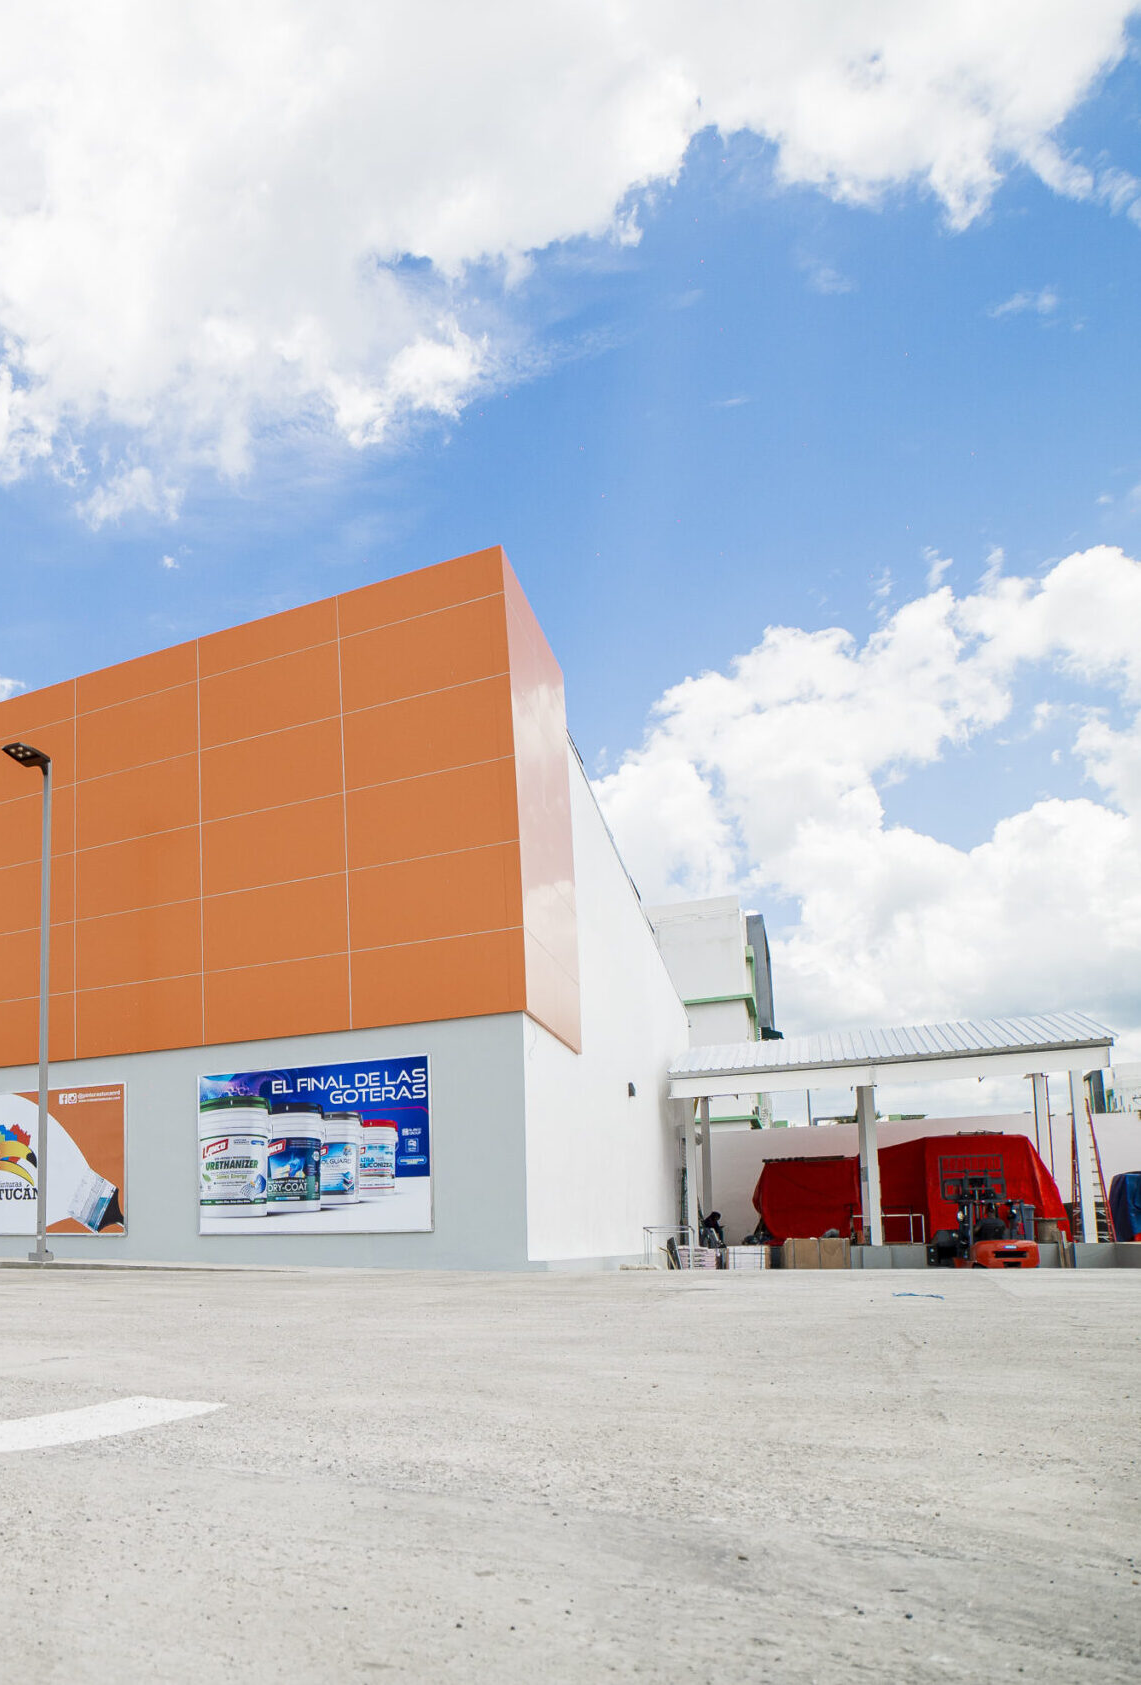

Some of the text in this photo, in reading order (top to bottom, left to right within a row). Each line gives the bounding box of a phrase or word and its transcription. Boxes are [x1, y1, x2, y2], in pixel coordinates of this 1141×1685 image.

[272, 1068, 426, 1094] EL FINAL DE LAS
[329, 1083, 427, 1105] GOTERAS
[206, 1160, 258, 1171] URETHANIZER
